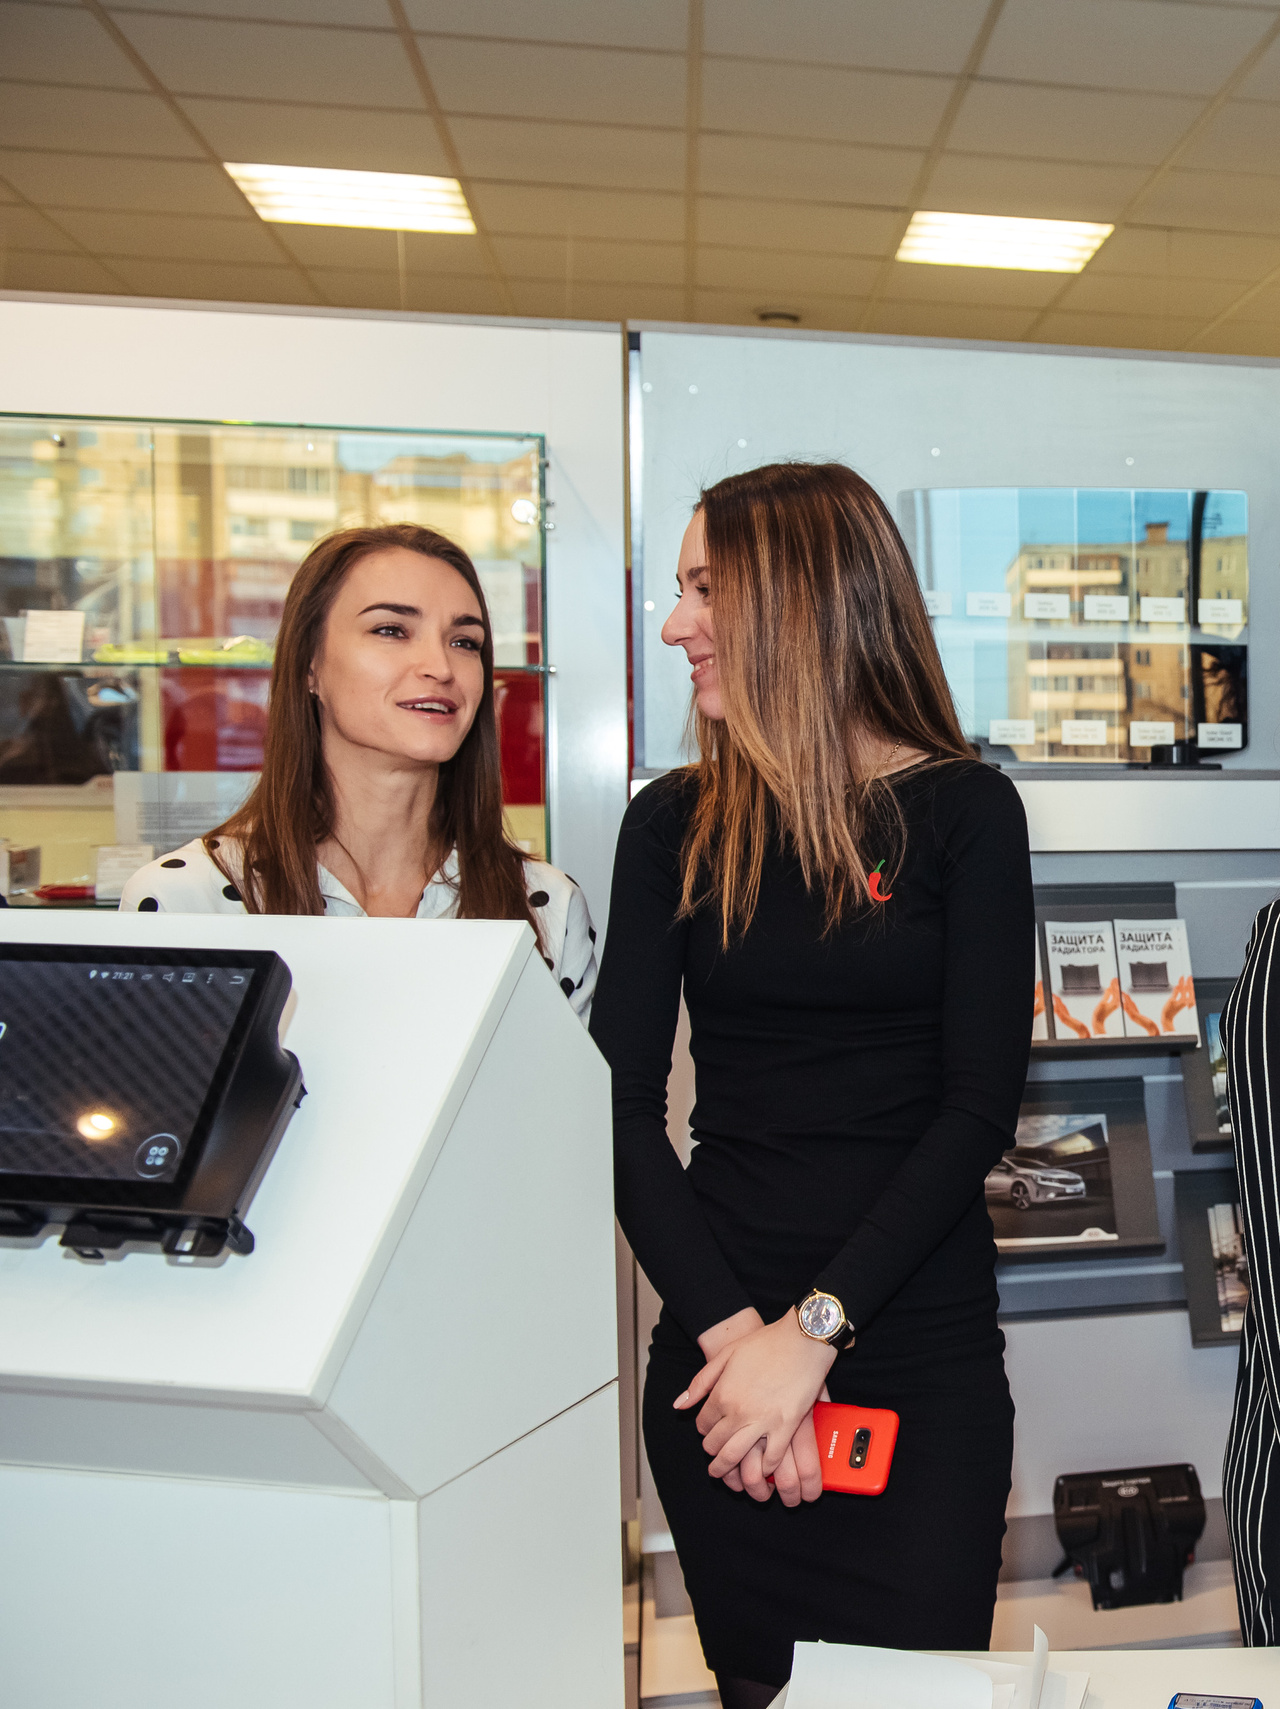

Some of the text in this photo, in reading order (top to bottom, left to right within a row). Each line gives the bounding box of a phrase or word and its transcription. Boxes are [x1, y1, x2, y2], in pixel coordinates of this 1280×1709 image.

[1051, 934, 1105, 945] ЗАЩИТА
[1119, 932, 1173, 944] ЗАЩИТА
[1051, 945, 1105, 954] РАДИАТОРА
[1119, 944, 1173, 952] РАДИАТОРА
[112, 971, 135, 980] 21:21
[828, 1430, 839, 1459] SAMSUNG
